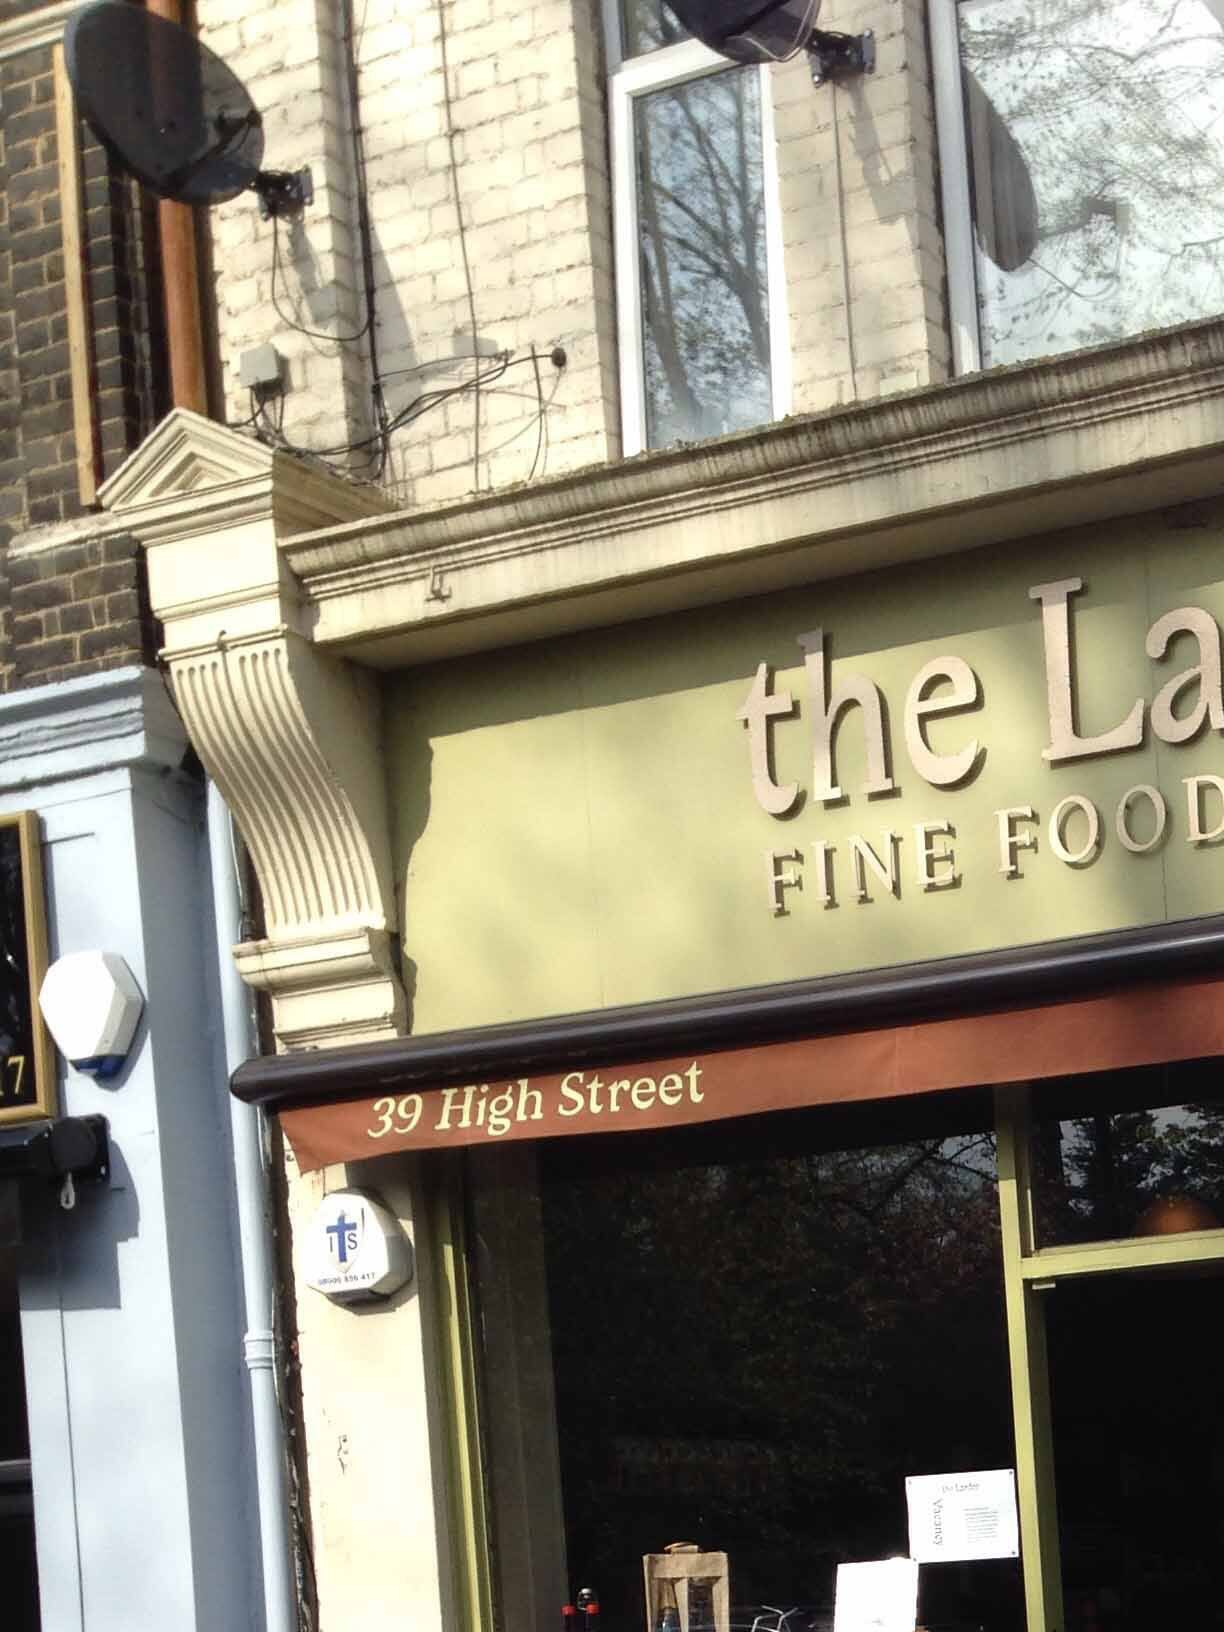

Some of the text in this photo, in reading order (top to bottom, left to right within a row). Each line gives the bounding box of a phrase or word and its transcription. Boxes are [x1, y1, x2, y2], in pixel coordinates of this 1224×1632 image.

[735, 628, 982, 815] the
[763, 822, 957, 914] FINE
[367, 1061, 704, 1138] 39 High Street
[932, 1498, 944, 1546] Vacancy
